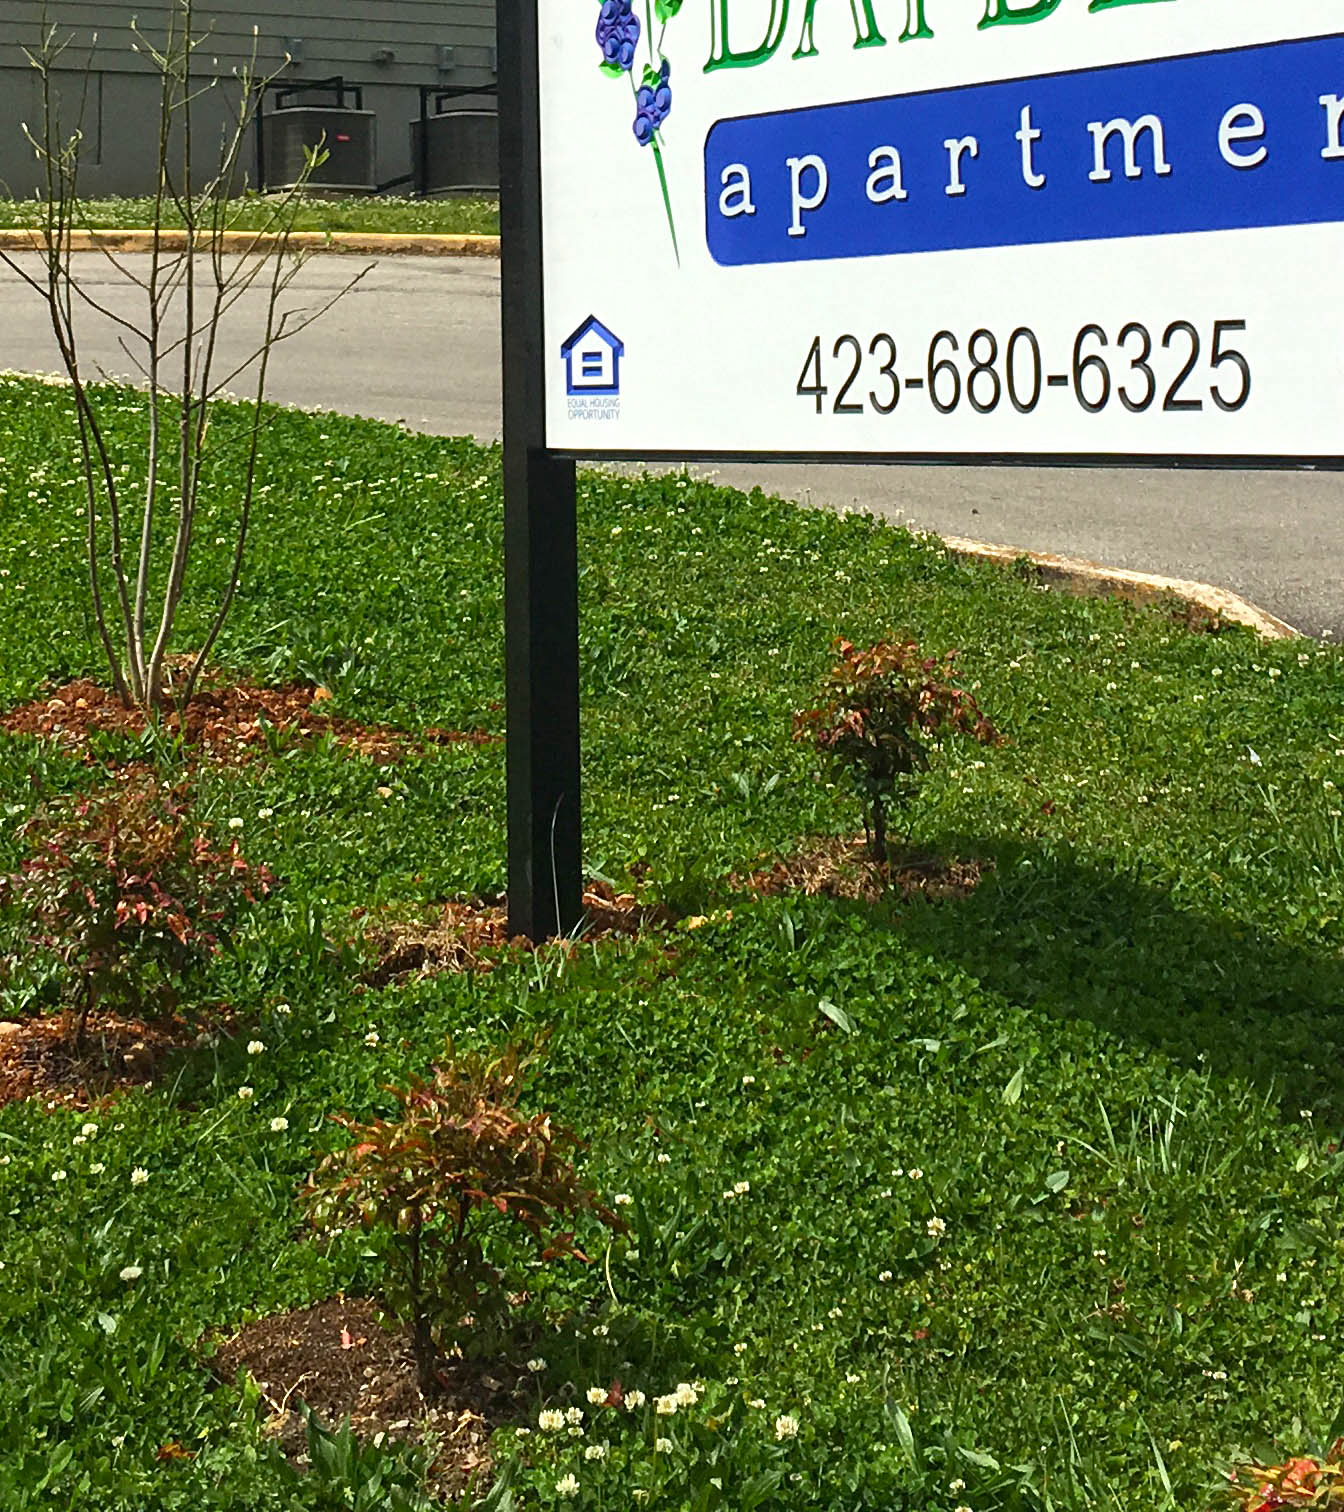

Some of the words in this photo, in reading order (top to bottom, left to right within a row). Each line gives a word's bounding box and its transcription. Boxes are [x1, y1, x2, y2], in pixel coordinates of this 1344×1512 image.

[797, 320, 1252, 414] 423-680-6325
[567, 398, 588, 409] EQUAL
[589, 398, 620, 408] HOUSING
[567, 409, 620, 420] OPPORTUNITY
